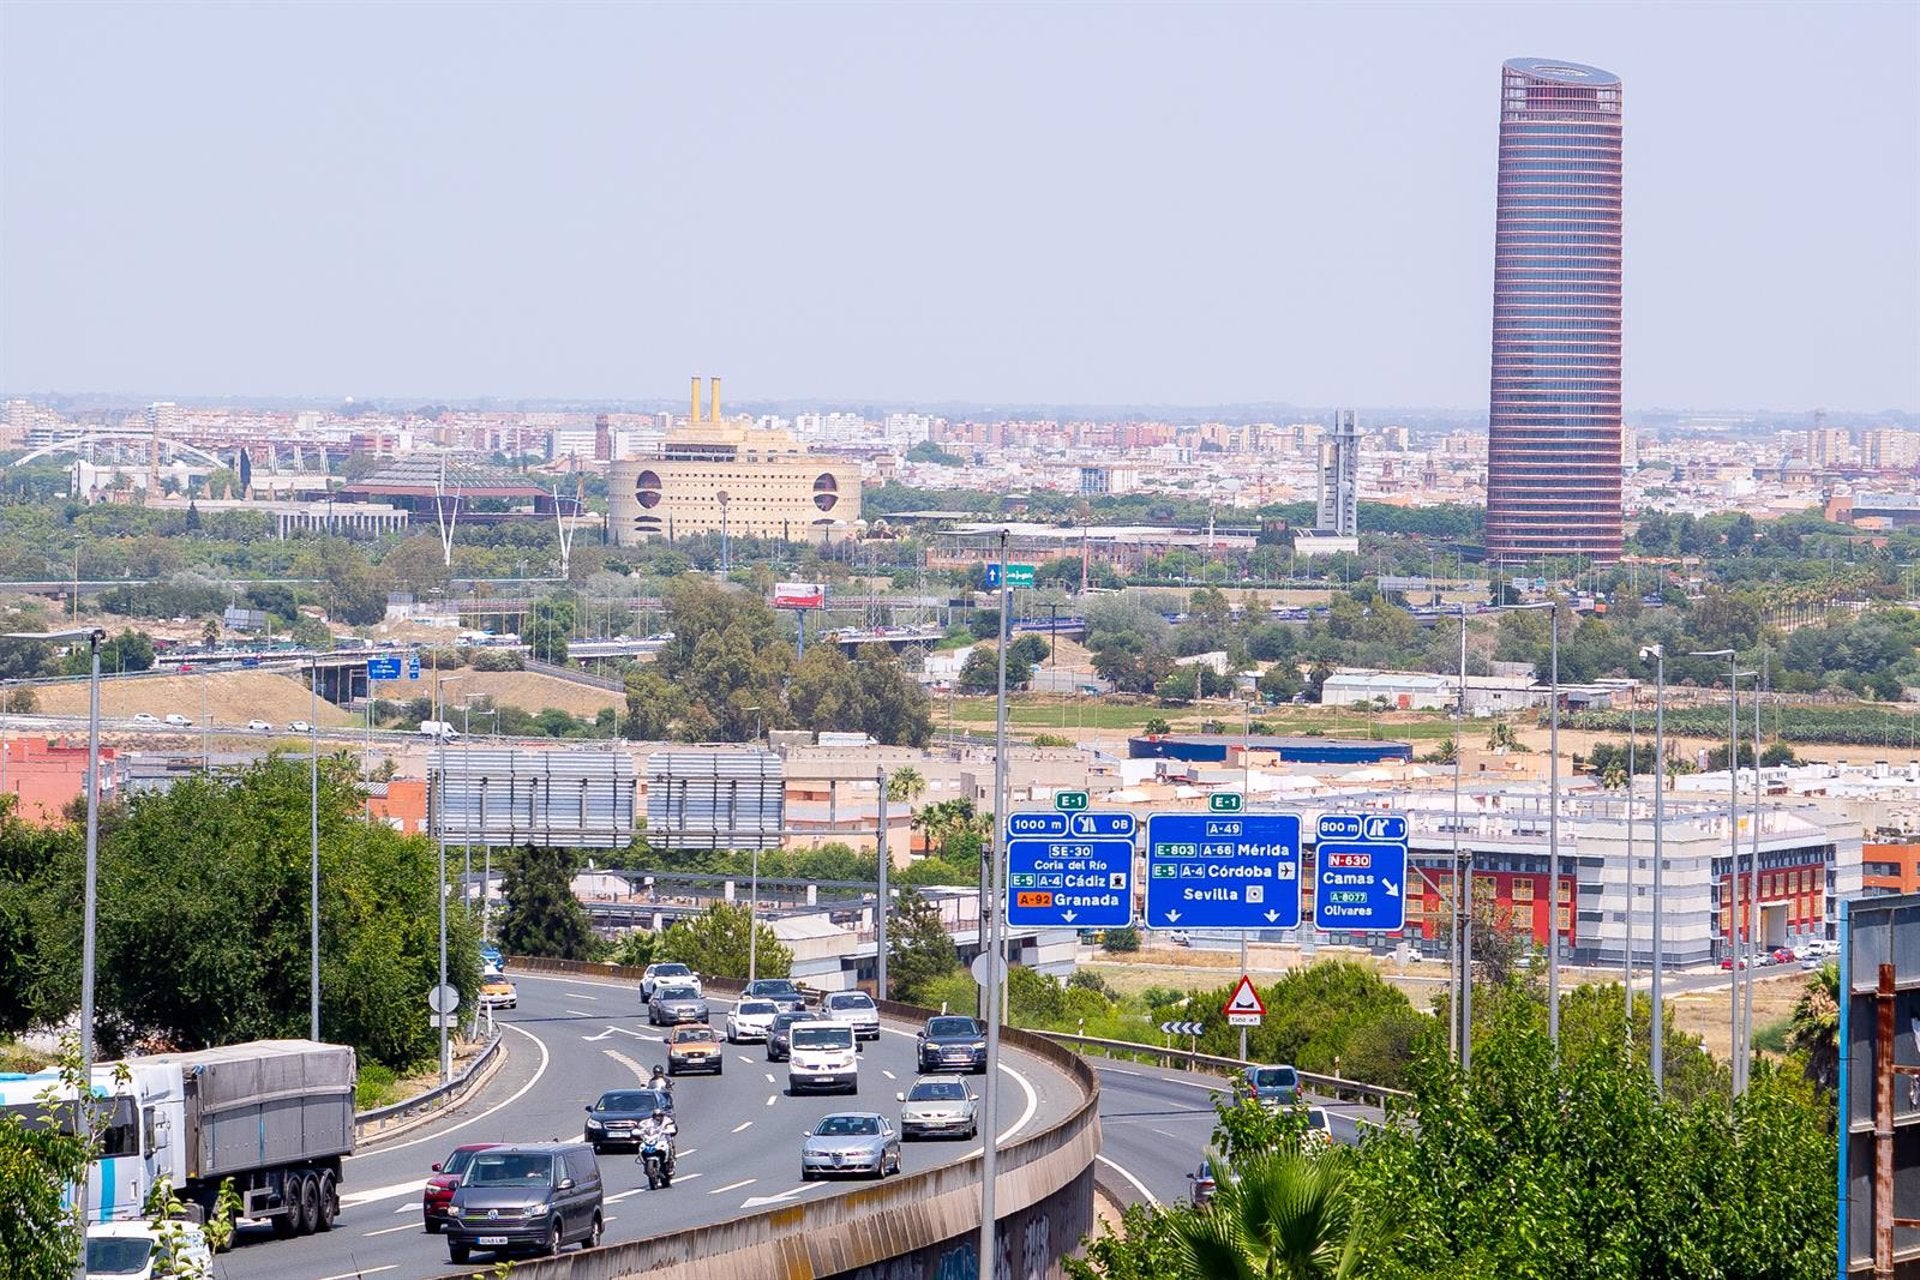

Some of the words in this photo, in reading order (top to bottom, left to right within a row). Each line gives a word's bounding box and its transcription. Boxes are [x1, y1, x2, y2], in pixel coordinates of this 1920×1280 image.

[1061, 796, 1083, 806] E-1
[1215, 797, 1237, 807] E-1
[1015, 819, 1046, 830] 1000
[1051, 821, 1062, 830] m
[1112, 819, 1129, 830] 0B
[1209, 824, 1240, 834] A-49
[1320, 822, 1345, 832] 800
[1347, 824, 1358, 832] m
[1051, 847, 1091, 856] SE-30
[1157, 845, 1195, 855] E-803
[1203, 845, 1232, 855] A-66
[1238, 844, 1290, 856] Mérida
[1034, 860, 1064, 870] Coria
[1068, 860, 1086, 870] del
[1089, 860, 1107, 870] Río
[1330, 855, 1369, 866] N-630
[1153, 866, 1175, 876] E-5
[1181, 866, 1203, 876] A-4
[1208, 864, 1272, 877] Córdoba
[1013, 876, 1034, 886] E-5
[1039, 876, 1060, 886] A-4
[1065, 875, 1106, 887] Cádiz
[1323, 872, 1375, 884] Camas
[1020, 894, 1050, 904] A-92
[1054, 893, 1119, 906] Granada
[1183, 888, 1239, 900] Sevilla
[1324, 905, 1372, 916] Olivares
